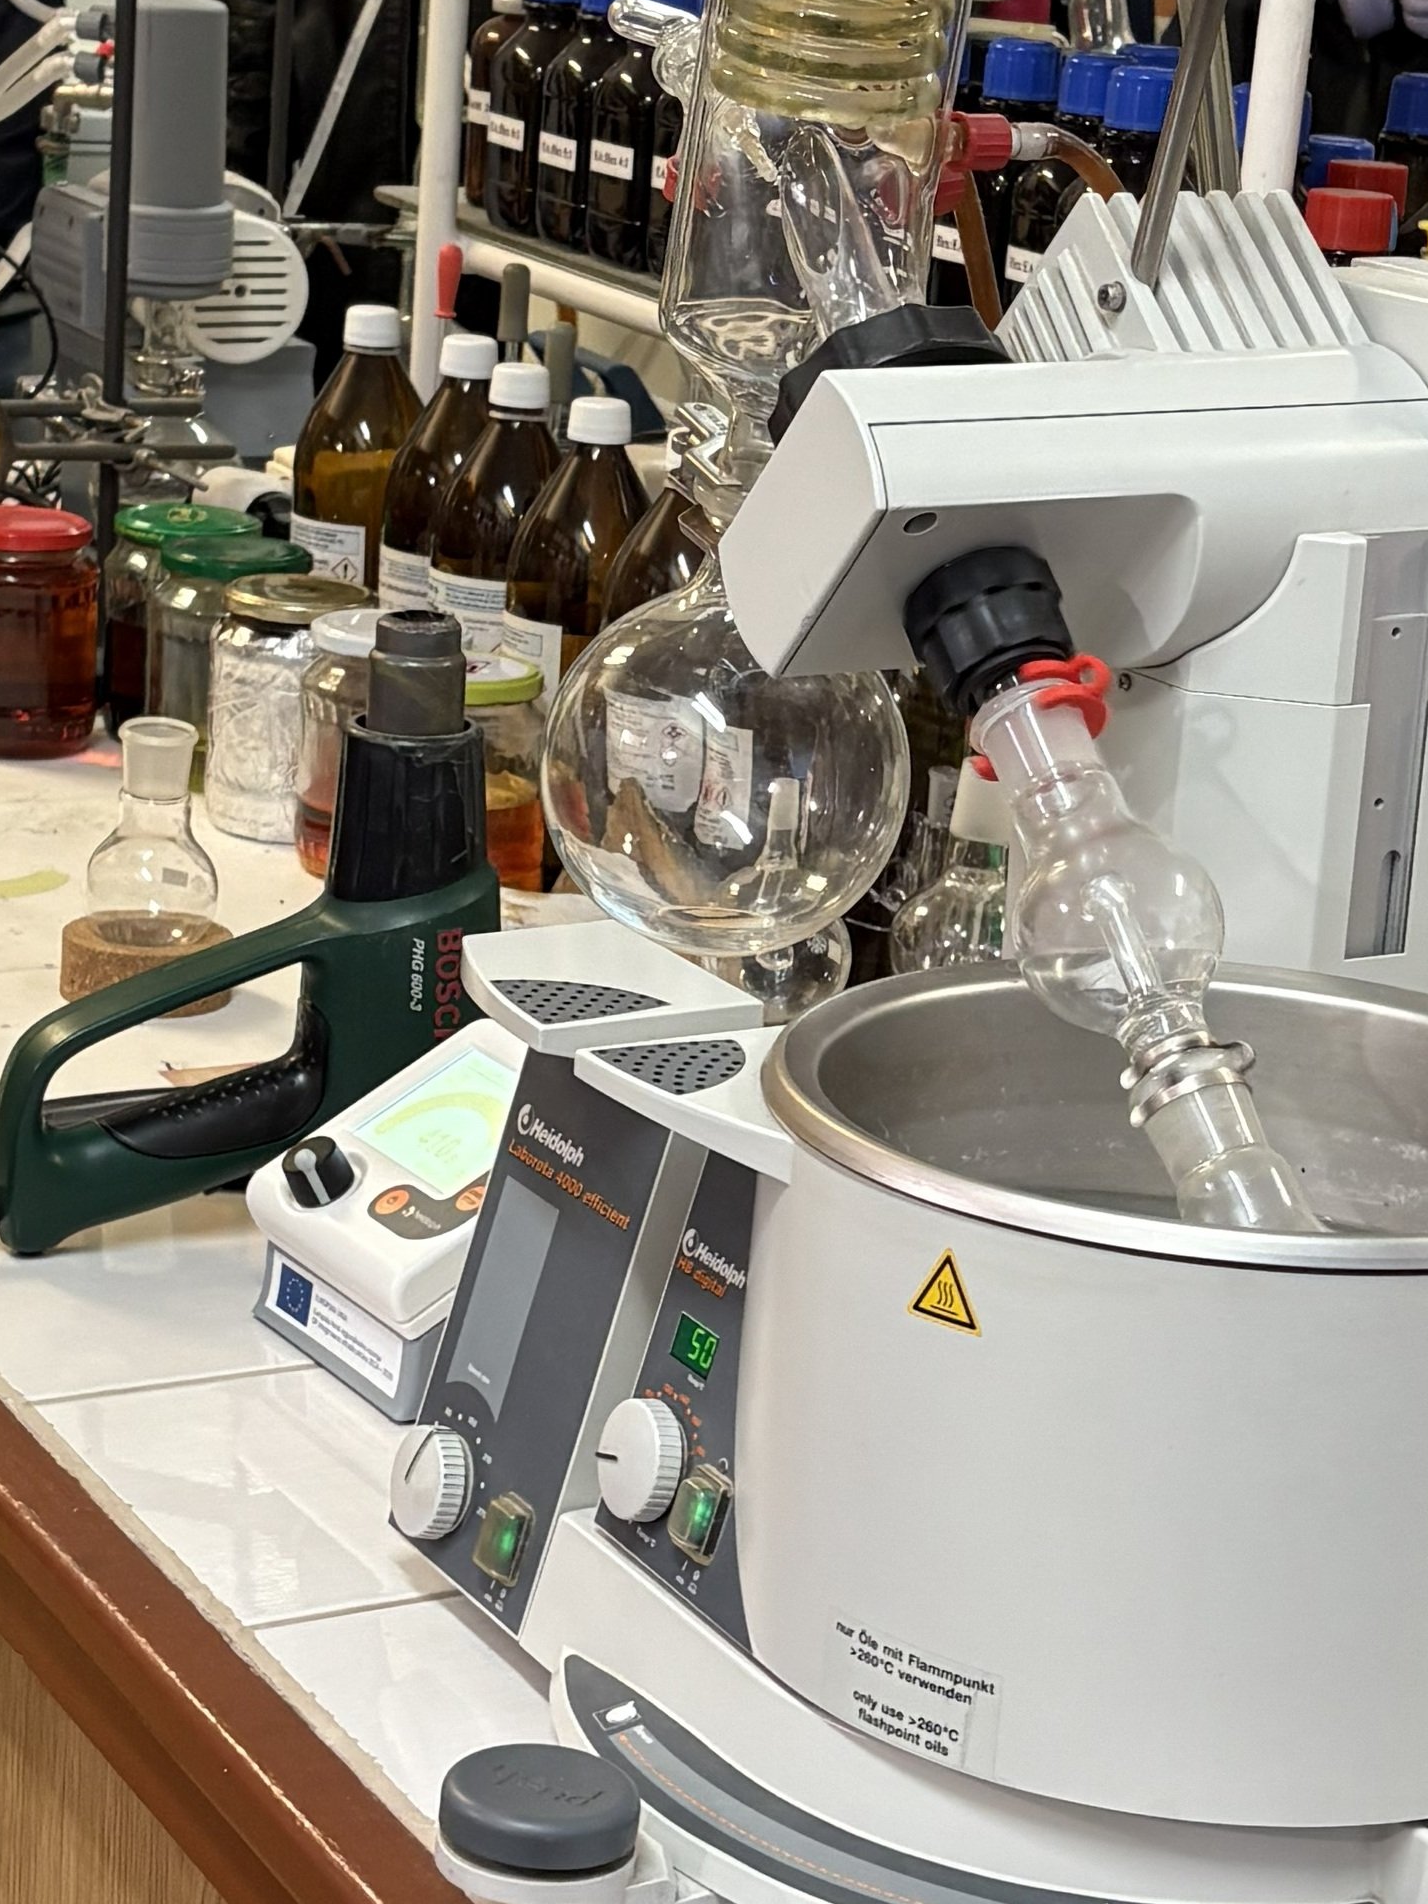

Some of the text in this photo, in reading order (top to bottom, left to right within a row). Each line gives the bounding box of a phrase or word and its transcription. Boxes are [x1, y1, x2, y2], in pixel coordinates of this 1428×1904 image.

[411, 937, 426, 972] PHG
[529, 1117, 585, 1168] Heidolph
[508, 1138, 555, 1179] Laborota
[555, 1171, 584, 1197] 4000
[583, 1191, 631, 1231] efficient
[693, 1268, 728, 1299] digital
[694, 1242, 746, 1290] Heidolph
[687, 1327, 717, 1369] 50
[835, 1621, 996, 1695] nur Öle mit Flammpunkt
[852, 1690, 878, 1712] only
[881, 1704, 905, 1722] use
[898, 1669, 973, 1706] verwenden
[857, 1707, 949, 1757] flashpoint oils
